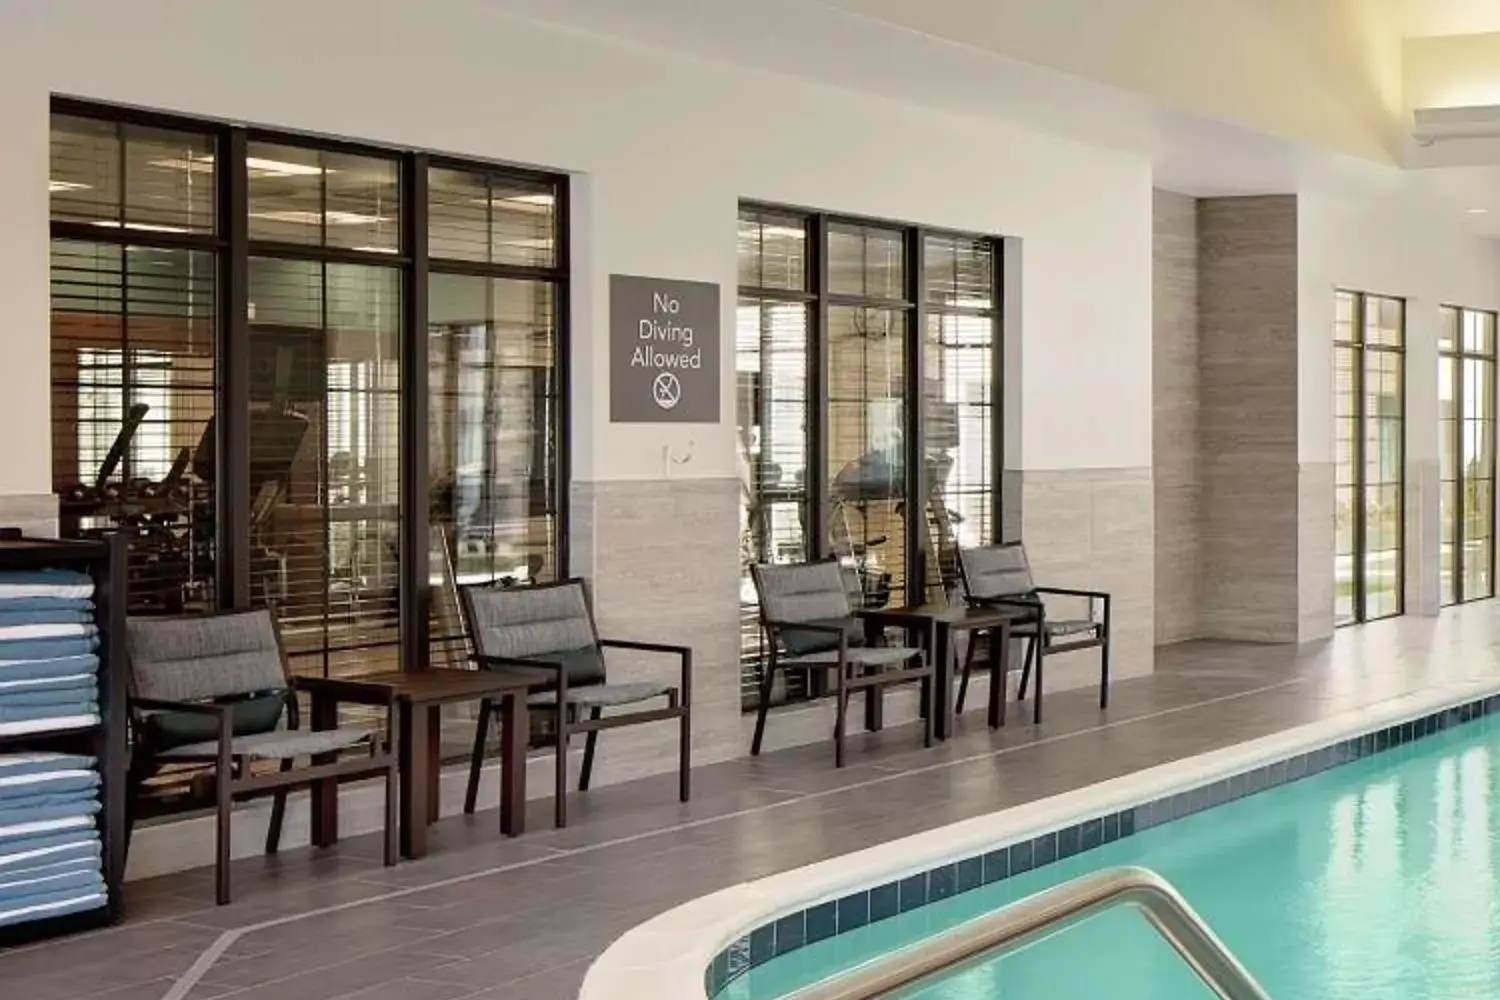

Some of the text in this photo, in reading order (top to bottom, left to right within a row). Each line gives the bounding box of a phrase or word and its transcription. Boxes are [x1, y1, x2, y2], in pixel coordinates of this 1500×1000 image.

[653, 292, 680, 313] No
[639, 319, 693, 347] Diving
[630, 346, 701, 369] Allowed
